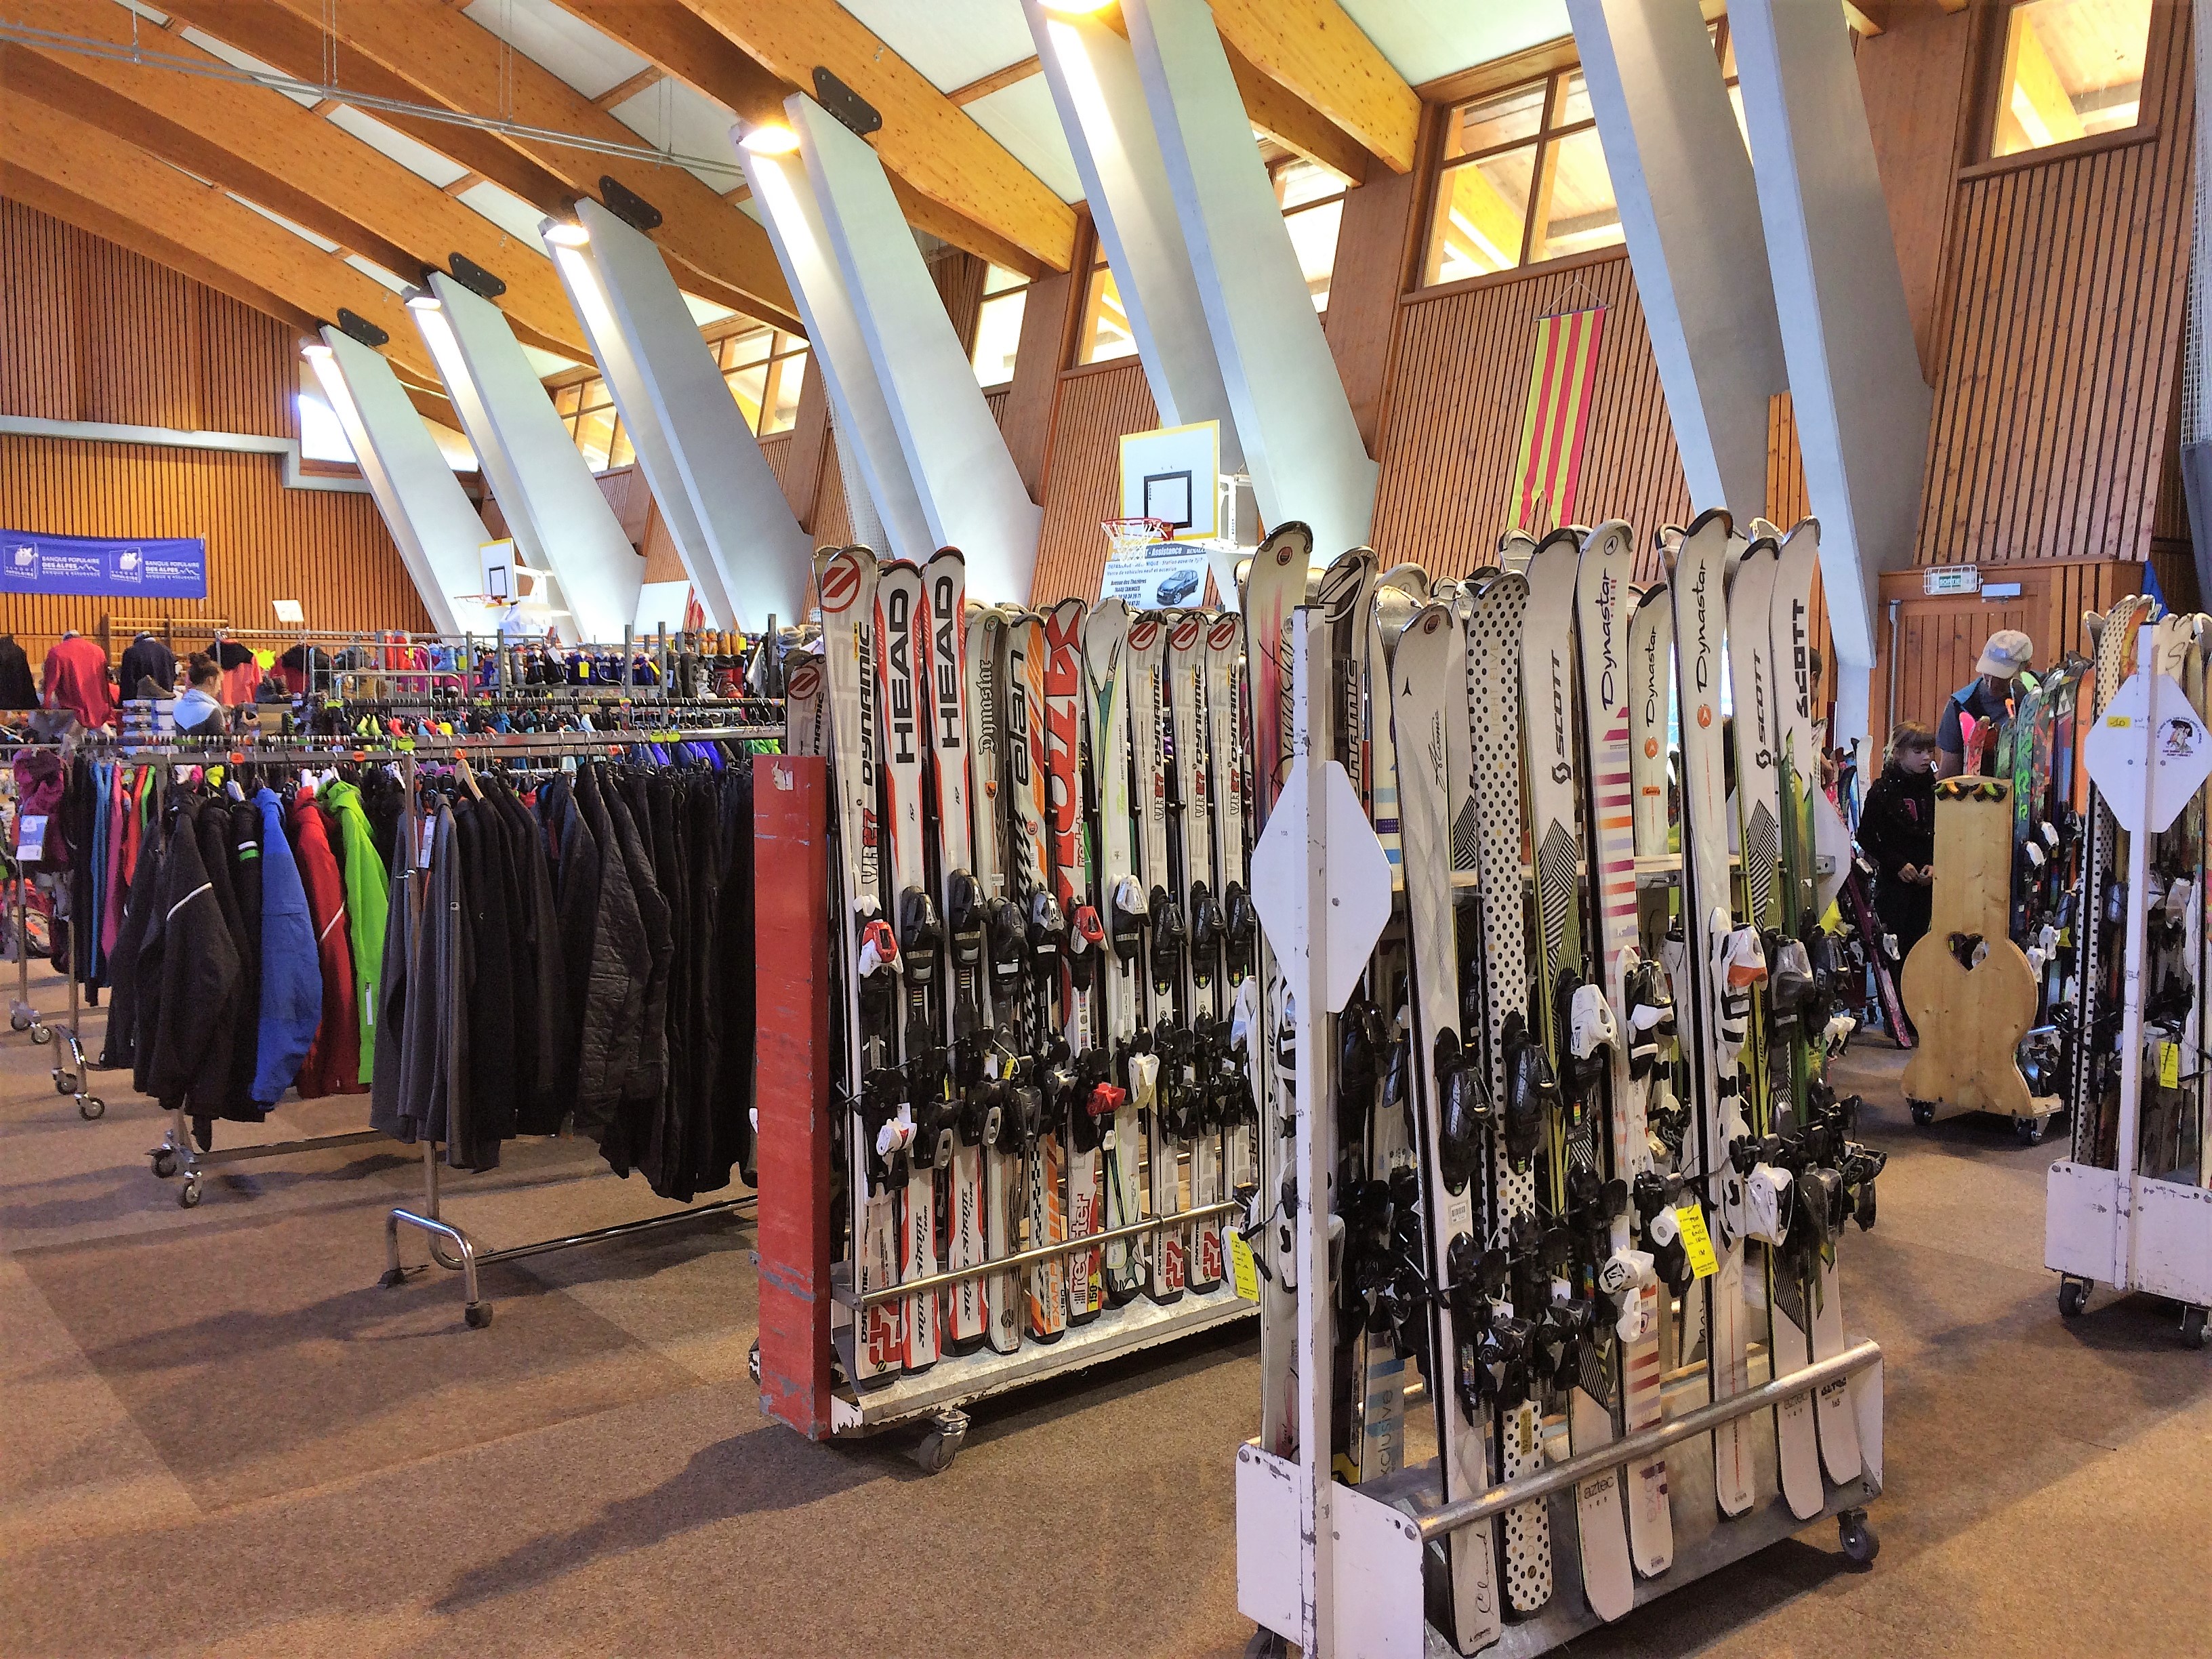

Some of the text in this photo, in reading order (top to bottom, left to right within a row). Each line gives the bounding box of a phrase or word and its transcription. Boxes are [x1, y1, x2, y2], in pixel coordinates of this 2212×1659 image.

[890, 588, 915, 763] HEAD
[935, 576, 960, 748] HEAD
[1594, 567, 1617, 711] Dynastar
[1643, 625, 1659, 728] Dynastar
[1692, 558, 1711, 693] Dynastar
[1793, 598, 1809, 718] SCOTT
[859, 621, 873, 787] DYNAMIC
[976, 658, 998, 755] Dynastar
[1010, 649, 1029, 786] elan
[1151, 663, 1162, 767] DYNAMIC
[1194, 663, 1202, 765] DYNAMIC
[1230, 663, 1238, 763] DYNAMIC
[1490, 689, 1500, 737] LIGHT
[1551, 649, 1565, 758] SCOTT
[1753, 648, 1768, 745] SCOTT
[1154, 772, 1164, 821] VR27
[1195, 770, 1206, 818] VR27
[1230, 768, 1241, 815] VR27
[1051, 1282, 1061, 1327] EXAR
[1377, 1390, 1393, 1476] xclusive
[1583, 1475, 1614, 1500] aztec
